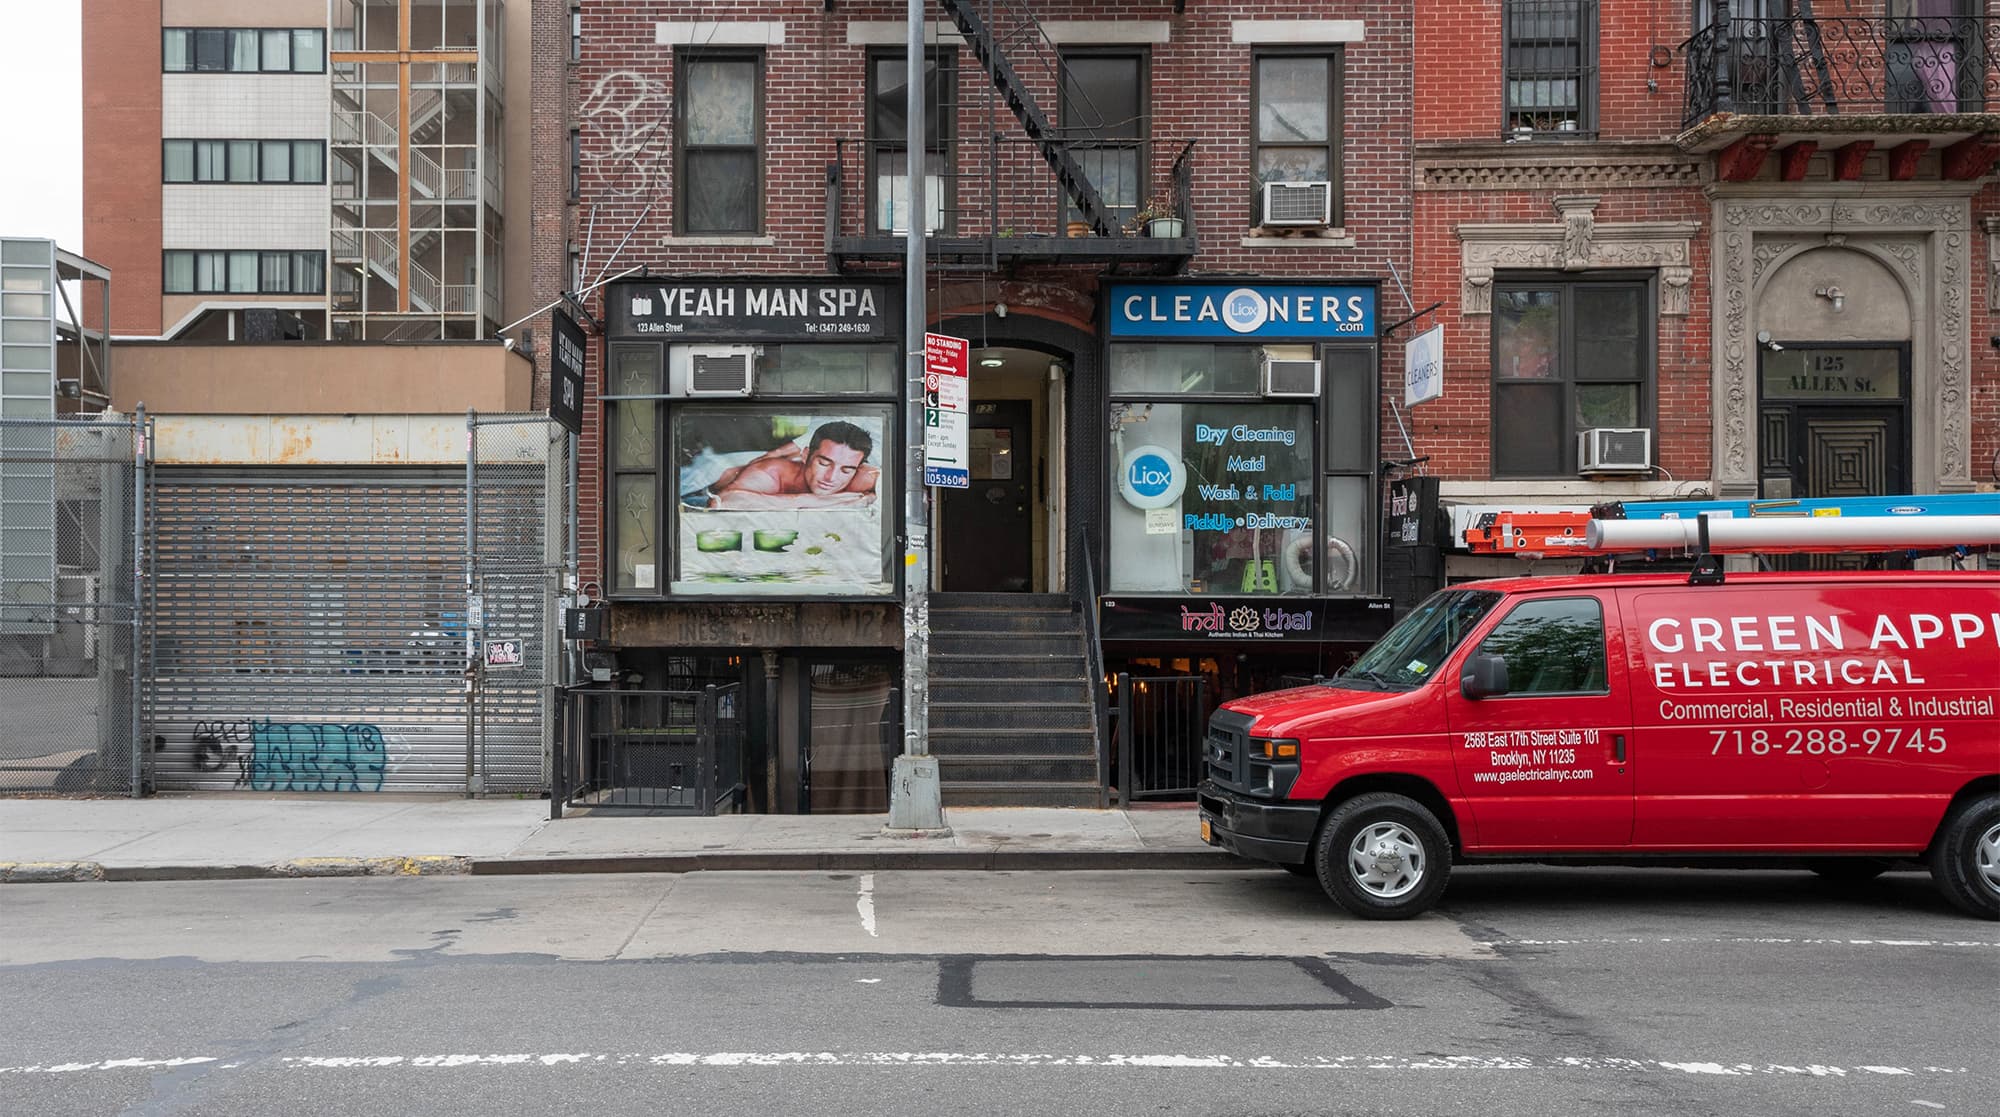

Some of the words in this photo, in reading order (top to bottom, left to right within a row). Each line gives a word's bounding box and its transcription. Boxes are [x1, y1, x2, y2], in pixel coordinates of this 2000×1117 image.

[659, 288, 735, 316] YEAH
[745, 288, 808, 316] MAN
[819, 288, 877, 316] SPA
[1231, 302, 1257, 317] Liox
[637, 322, 649, 332] 123
[649, 322, 665, 332] Allen
[666, 322, 684, 332] Street
[805, 323, 818, 333] Tel:
[820, 323, 837, 334] (347)
[838, 323, 871, 333] 249-1630
[1335, 321, 1364, 332] .com
[927, 337, 936, 345] NO
[936, 339, 962, 350] STANDING
[1407, 360, 1438, 386] CLEANERS
[1815, 356, 1844, 371] 125
[563, 375, 575, 411] SPA
[1787, 376, 1849, 392] ALLEN
[1854, 376, 1877, 393] St.
[929, 411, 937, 426] 2
[1196, 425, 1228, 446] Dry
[1232, 425, 1296, 446] Cleaning
[1227, 455, 1266, 472] Maid
[1131, 465, 1171, 486] Liox
[1199, 484, 1240, 501] Wash
[1244, 485, 1258, 501] &
[1263, 484, 1296, 501] Fold
[1184, 513, 1235, 533] PickUp
[1246, 512, 1310, 532] Delivery
[1181, 602, 1226, 631] indi
[1262, 607, 1313, 631] thai
[1648, 615, 1844, 653] GREEN
[1654, 659, 1926, 687] ELECTRICAL
[1659, 698, 1774, 721] Commercial,
[1779, 696, 1883, 718] Residential
[1889, 696, 1903, 717] &
[1908, 695, 1994, 717] Industrial
[1464, 733, 1486, 748] 2568
[1488, 732, 1508, 747] East
[1510, 731, 1529, 746] 17th
[1531, 730, 1557, 746] Street
[1559, 729, 1582, 745] Suite
[1584, 729, 1600, 745] 101
[1709, 727, 1947, 756] 718-288-9745
[1490, 750, 1532, 769] Brooklyn,
[1533, 749, 1547, 764] NY
[1549, 748, 1575, 765] 11235
[1474, 768, 1594, 784] www.gaelectricalnyc.com
